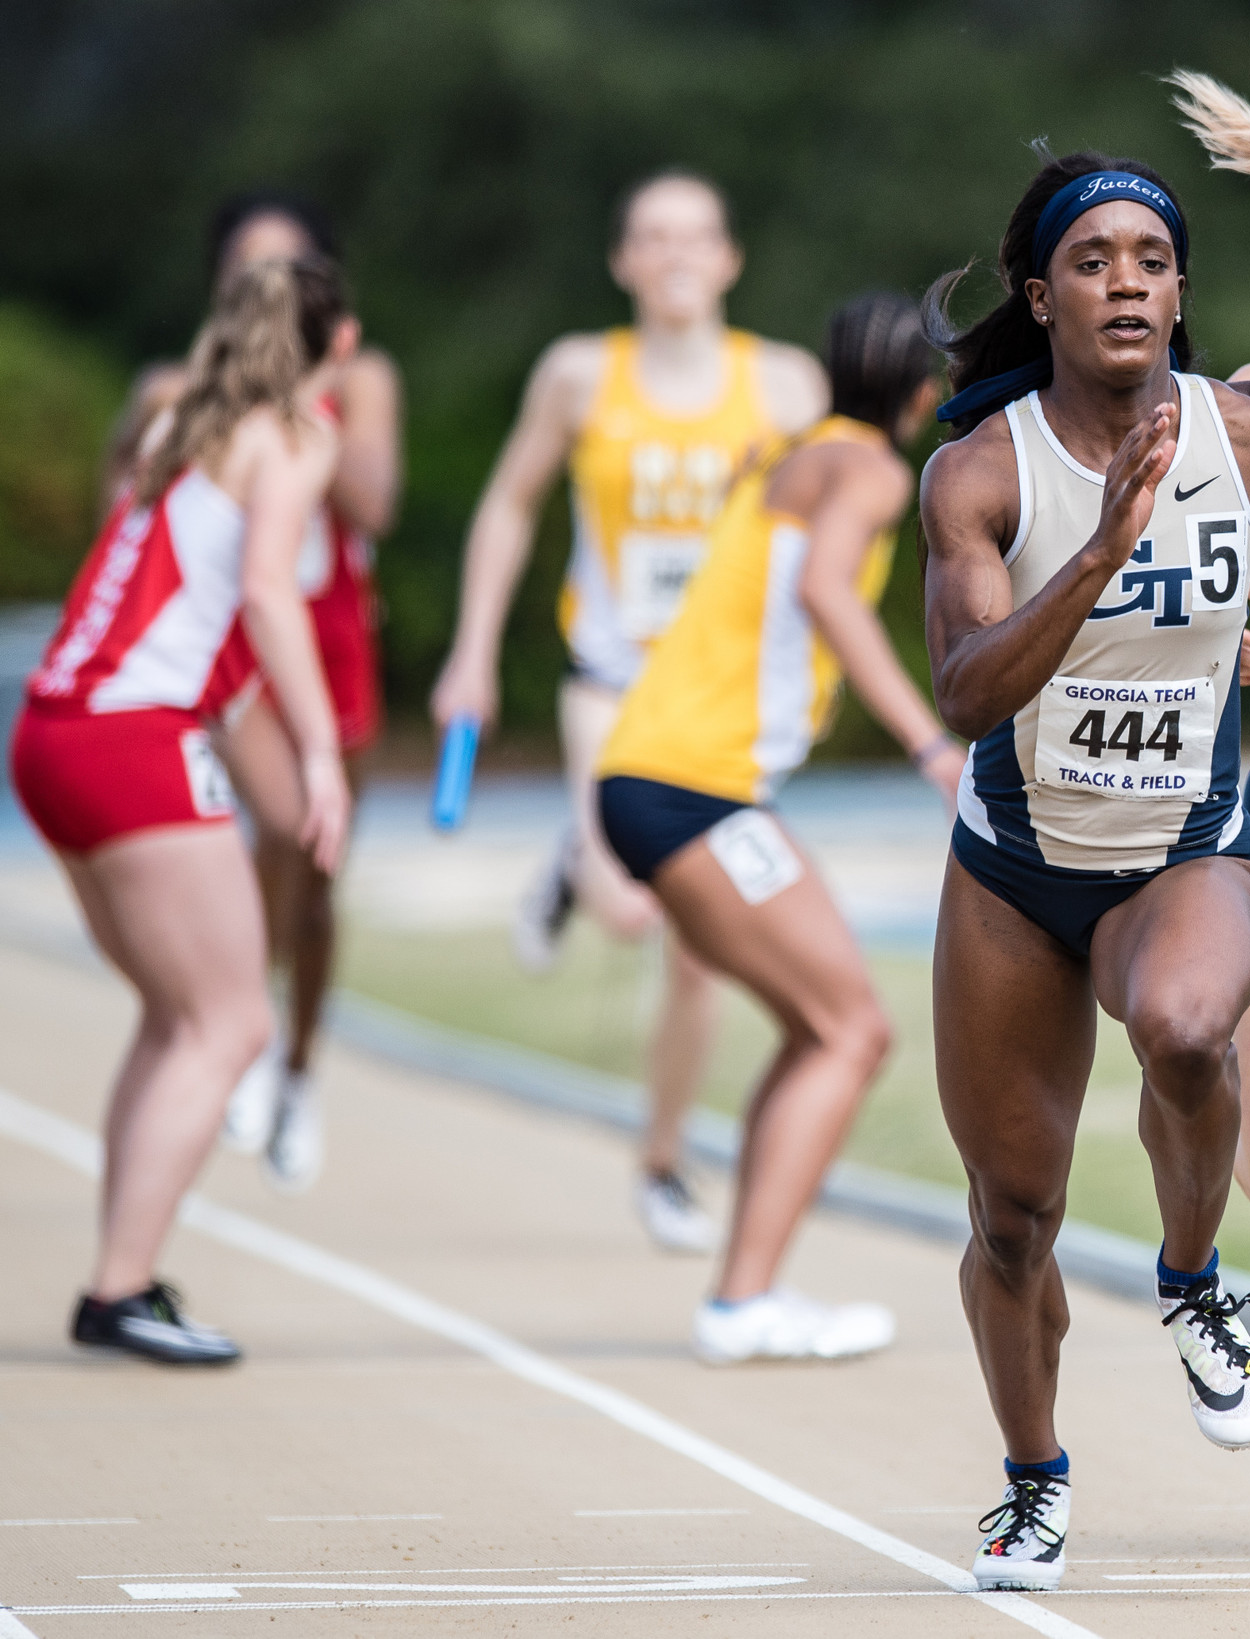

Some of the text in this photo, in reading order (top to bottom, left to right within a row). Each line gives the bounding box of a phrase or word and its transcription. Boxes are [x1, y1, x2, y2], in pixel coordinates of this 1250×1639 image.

[1080, 177, 1166, 207] Jackets
[1198, 519, 1239, 604] 5
[1065, 685, 1196, 702] GEORGIA TECH
[1069, 709, 1183, 762] 444
[1058, 767, 1186, 789] TRACK & FIELD
